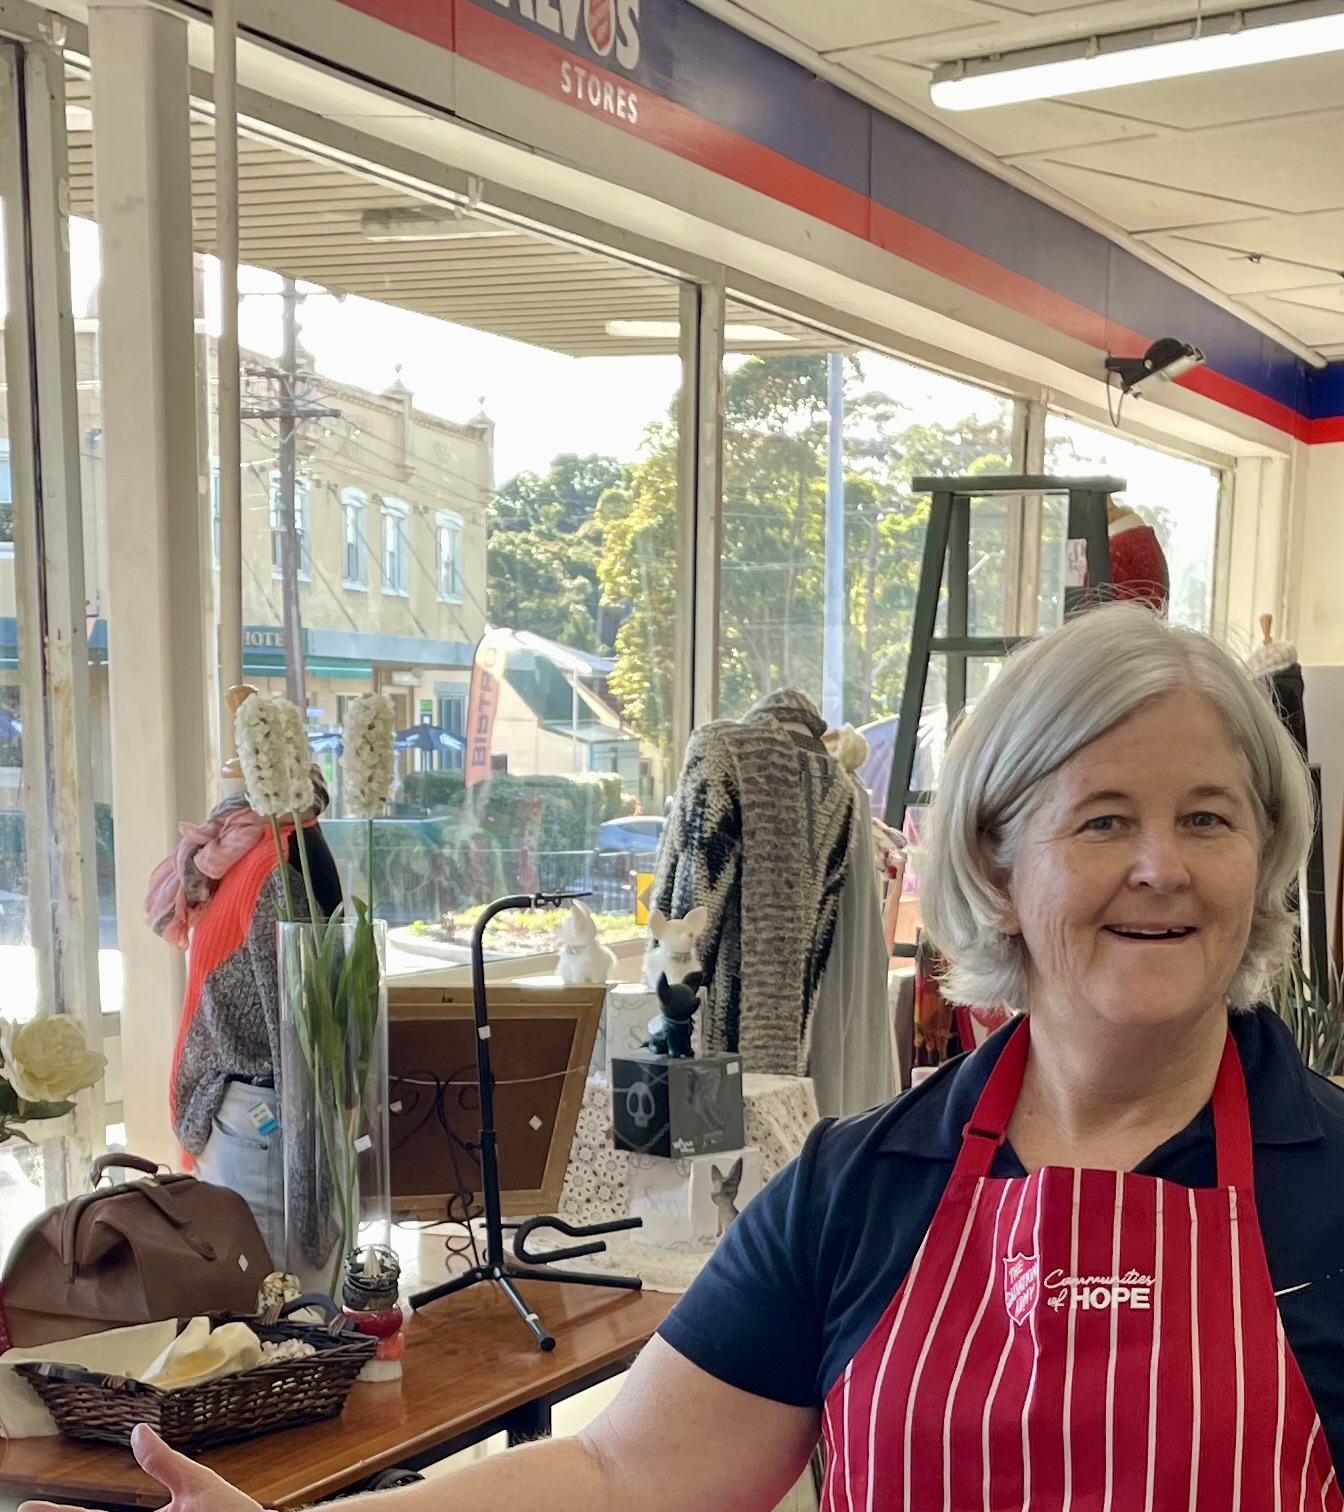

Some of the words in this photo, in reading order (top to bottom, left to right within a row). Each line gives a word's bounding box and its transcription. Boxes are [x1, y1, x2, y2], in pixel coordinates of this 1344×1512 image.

[561, 60, 639, 124] STORES
[241, 630, 286, 648] HOTE
[472, 646, 499, 767] BISTRO
[1044, 1268, 1155, 1289] Communities
[1047, 1287, 1068, 1313] of
[1070, 1287, 1151, 1310] HOPE
